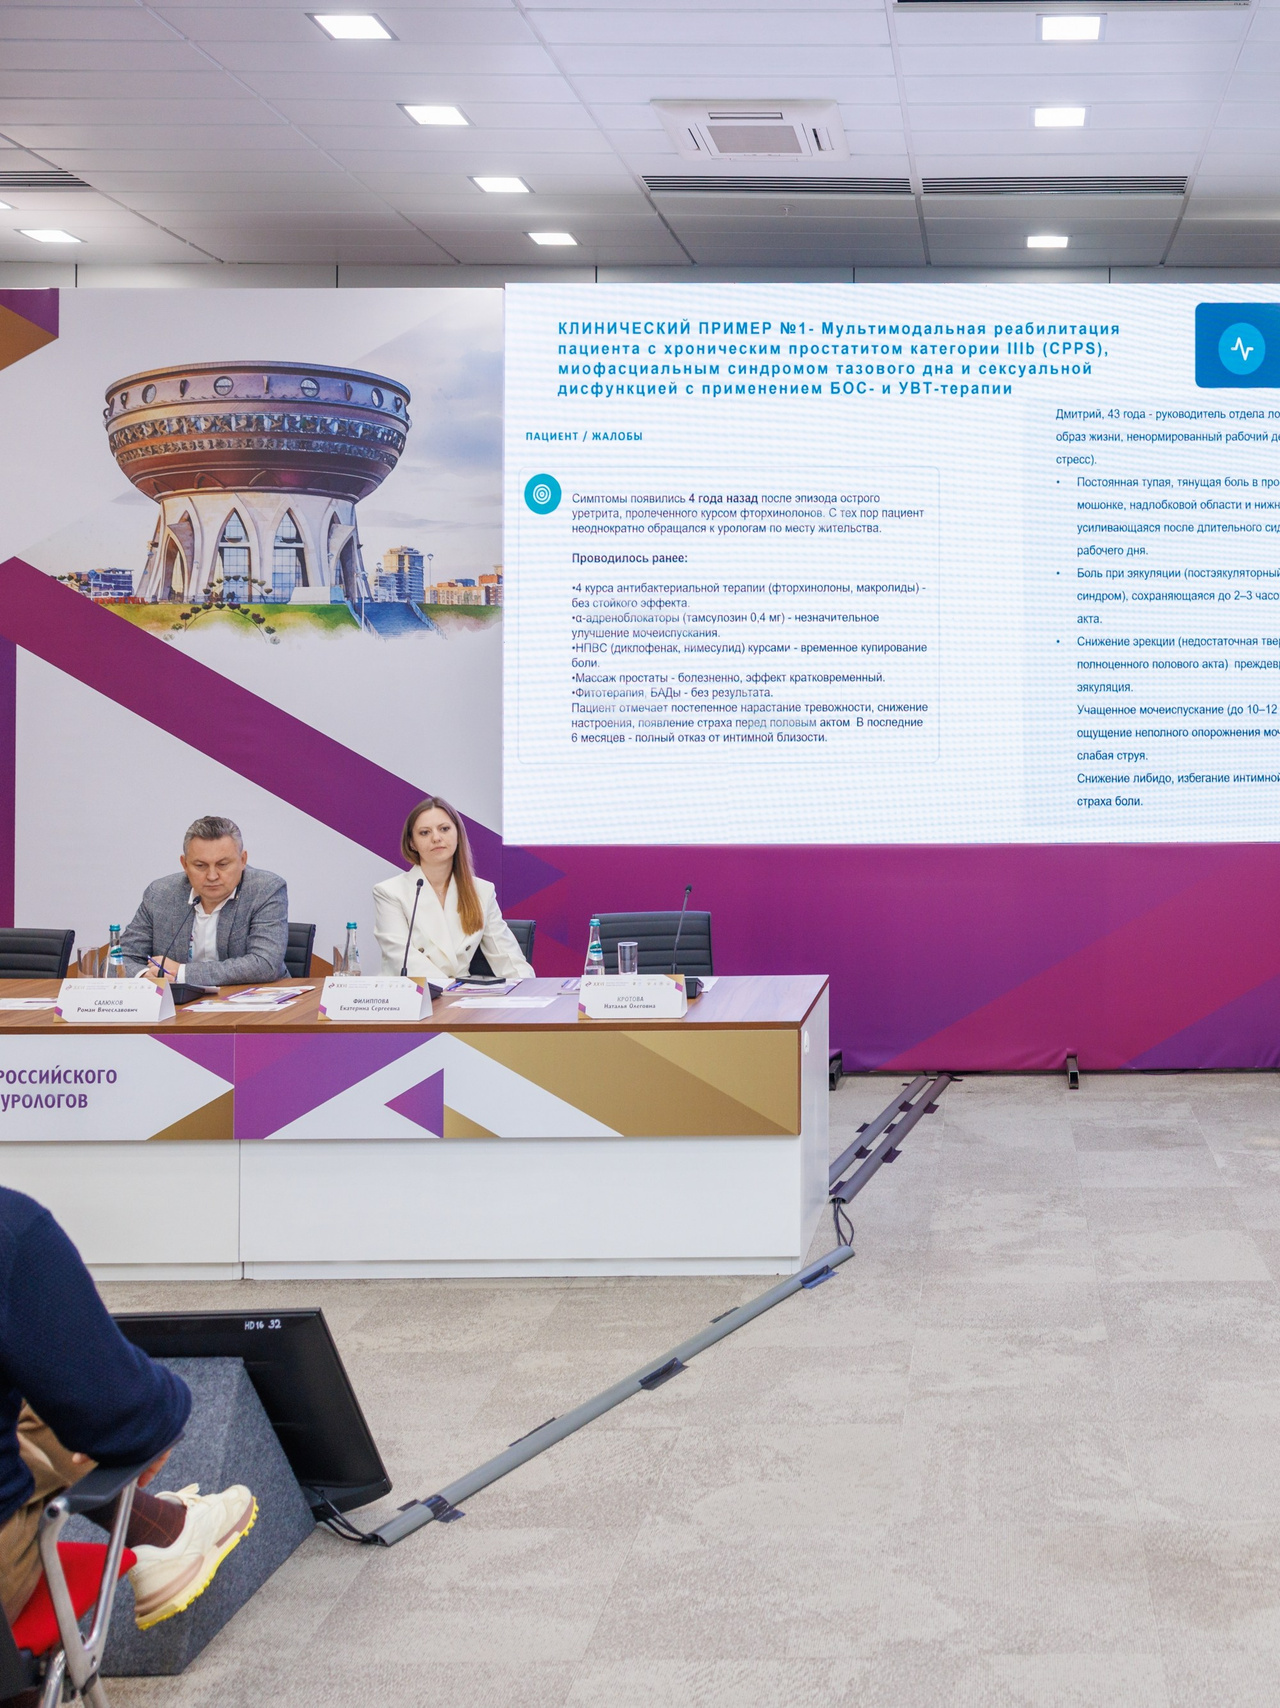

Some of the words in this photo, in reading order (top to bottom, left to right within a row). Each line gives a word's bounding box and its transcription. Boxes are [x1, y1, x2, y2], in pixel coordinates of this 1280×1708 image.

[558, 319, 690, 335] КЛИНИЧЕСКИЙ
[699, 321, 772, 335] ПРИМЕР
[780, 322, 814, 335] №1-
[822, 321, 986, 338] Мультимодальная
[994, 322, 1119, 338] реабилитация
[558, 344, 640, 357] пациента
[648, 344, 656, 355] с
[664, 344, 780, 358] хроническим
[789, 344, 902, 358] простатитом
[910, 344, 999, 358] категории
[1007, 342, 1035, 355] IIIb
[1043, 341, 1108, 358] (CPPS),
[558, 362, 720, 378] миофасциальным
[728, 364, 828, 378] синдромом
[836, 364, 915, 375] тазового
[922, 364, 953, 377] дна
[962, 365, 970, 375] и
[978, 362, 1091, 378] сексуальной
[557, 382, 677, 398] дисфункцией
[685, 384, 694, 395] с
[702, 384, 822, 398] применением
[830, 381, 874, 395] БОС-
[882, 384, 891, 394] и
[899, 381, 1012, 398] УВТ-терапии
[1055, 408, 1105, 421] Дмитрий,
[1107, 409, 1120, 419] 43
[1123, 410, 1146, 420] года
[1155, 410, 1226, 421] руководитель
[1229, 410, 1265, 420] отдела
[526, 432, 578, 442] ПАЦИЕНТ
[582, 431, 588, 442] /
[592, 431, 642, 441] ЖАЛОБЫ
[1055, 431, 1086, 443] образ
[1089, 433, 1123, 442] жизни,
[1126, 432, 1222, 444] ненормированный
[1225, 431, 1269, 444] рабочий
[1056, 454, 1097, 467] стресс).
[1077, 476, 1139, 487] Постоянная
[1142, 478, 1174, 489] тупая,
[1177, 479, 1222, 489] тянущая
[1224, 476, 1249, 487] боль
[1252, 478, 1258, 487] в
[572, 493, 628, 503] Симптомы
[630, 495, 686, 503] появились
[688, 493, 695, 503] 4
[698, 495, 723, 505] года
[726, 495, 759, 505] назад
[761, 495, 792, 503] после
[795, 495, 837, 504] эпизода
[840, 495, 880, 505] острого
[1077, 501, 1127, 511] мошонке,
[1129, 499, 1197, 511] надлобковой
[1200, 499, 1242, 510] области
[1245, 502, 1252, 510] и
[572, 510, 622, 521] уретрита,
[625, 509, 698, 520] пролеченного
[701, 509, 737, 521] курсом
[740, 508, 825, 521] фторхинолонов.
[840, 509, 857, 518] тех
[860, 509, 879, 520] пор
[882, 509, 924, 519] пациент
[572, 525, 645, 536] неоднократно
[647, 523, 707, 536] обращался
[709, 525, 715, 533] к
[717, 525, 767, 536] урологам
[769, 525, 782, 533] по
[785, 525, 815, 535] месту
[818, 524, 882, 533] жительства.
[1077, 524, 1161, 535] усиливающаяся
[1163, 524, 1194, 532] после
[1197, 524, 1262, 534] длительного
[1077, 545, 1124, 557] рабочего
[1126, 547, 1148, 557] дня.
[572, 553, 649, 565] Проводилось
[652, 555, 688, 565] ранее:
[1077, 567, 1103, 578] Боль
[1105, 569, 1124, 580] при
[1127, 570, 1181, 581] эякуляции
[1077, 636, 1130, 646] Снижение
[1133, 638, 1175, 648] эрекции
[1178, 636, 1258, 648] (недостаточная
[1077, 661, 1150, 671] полноценного
[1152, 661, 1200, 669] полового
[1201, 659, 1229, 671] акта)
[1077, 683, 1133, 694] эякуляция.
[571, 732, 578, 743] 6
[581, 729, 625, 744] месяцев
[635, 732, 675, 742] полный
[677, 734, 706, 742] отказ
[708, 734, 720, 742] от
[723, 732, 774, 742] интимной
[777, 731, 827, 742] близости.
[1077, 798, 1112, 809] страха
[1115, 795, 1143, 806] боли.
[1, 1094, 88, 1112] УРОЛОГОВ
